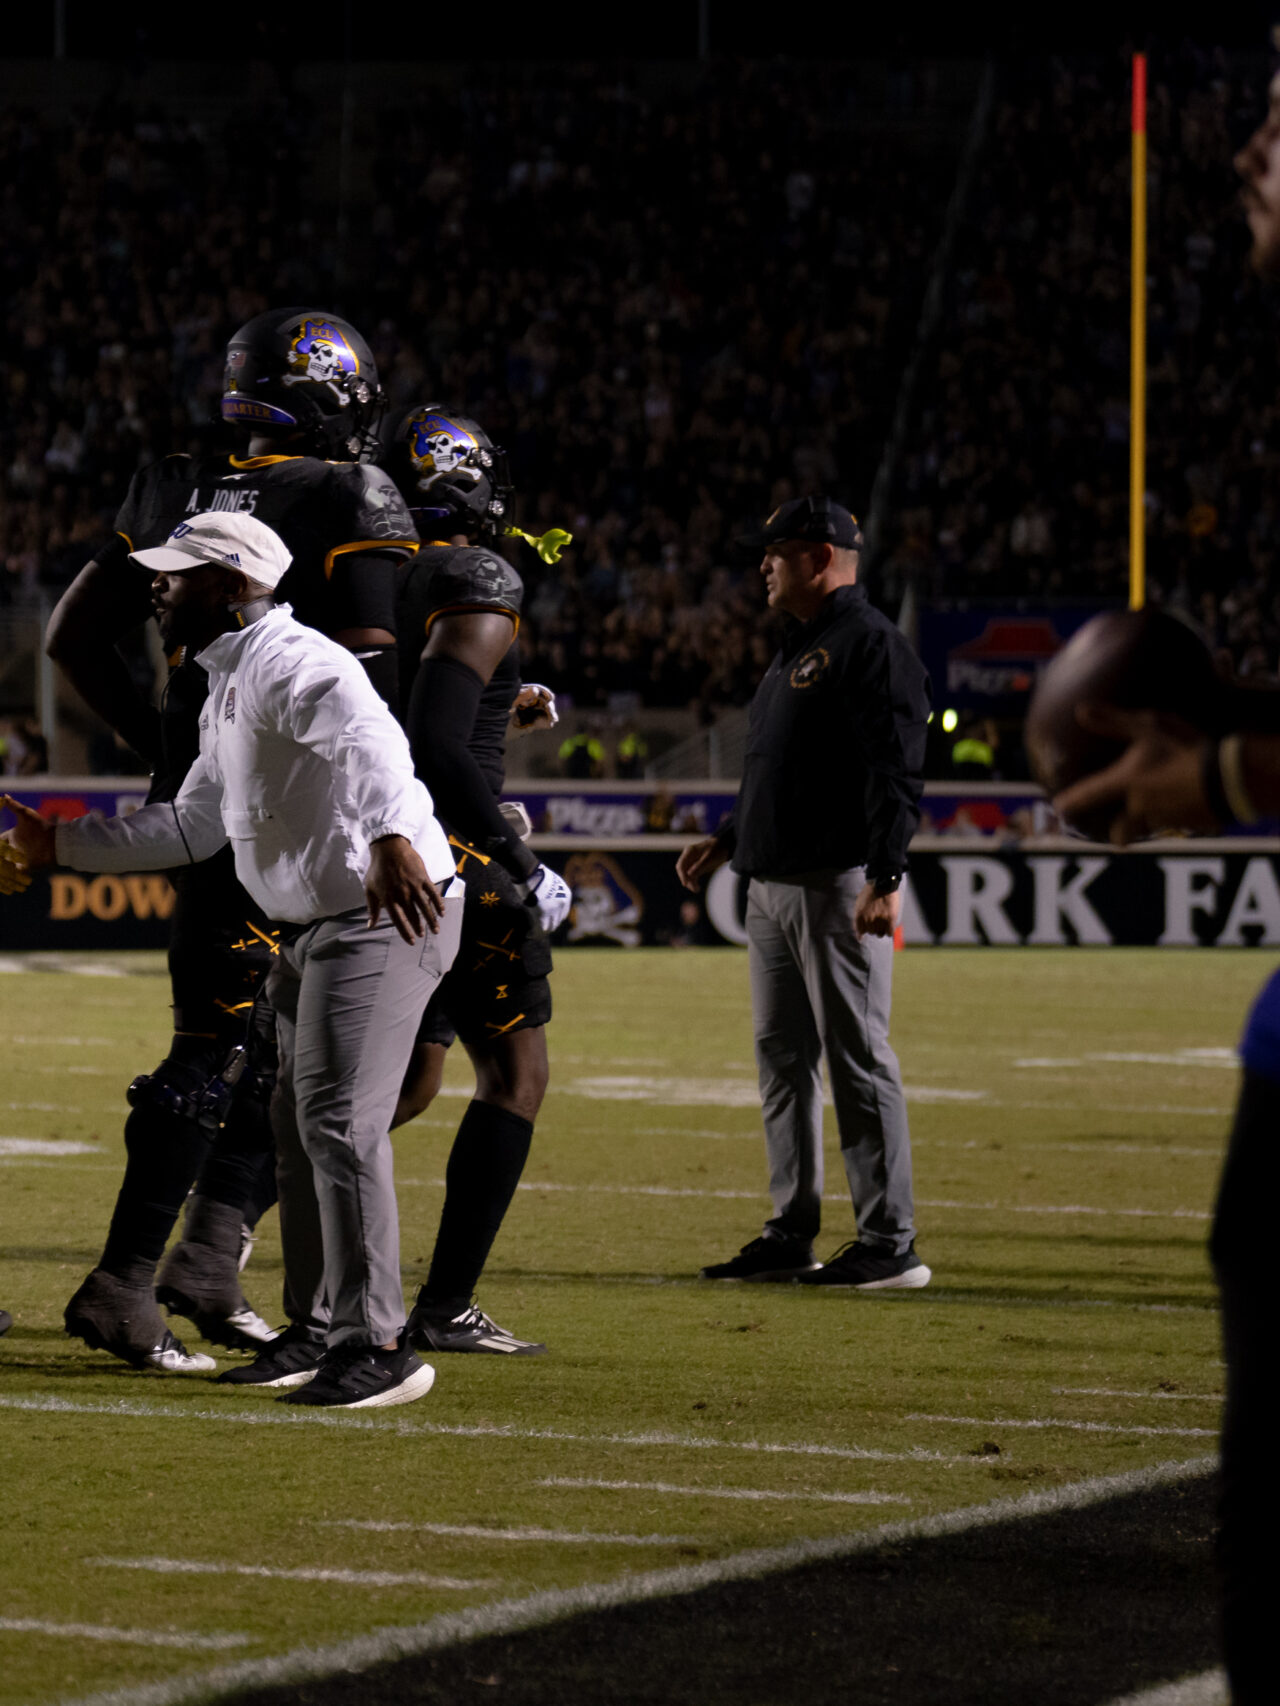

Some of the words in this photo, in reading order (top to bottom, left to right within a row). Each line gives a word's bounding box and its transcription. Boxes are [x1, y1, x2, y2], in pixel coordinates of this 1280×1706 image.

[310, 327, 334, 338] ECU
[419, 420, 440, 434] ECU
[185, 488, 200, 513] A.
[205, 489, 260, 515] JONES
